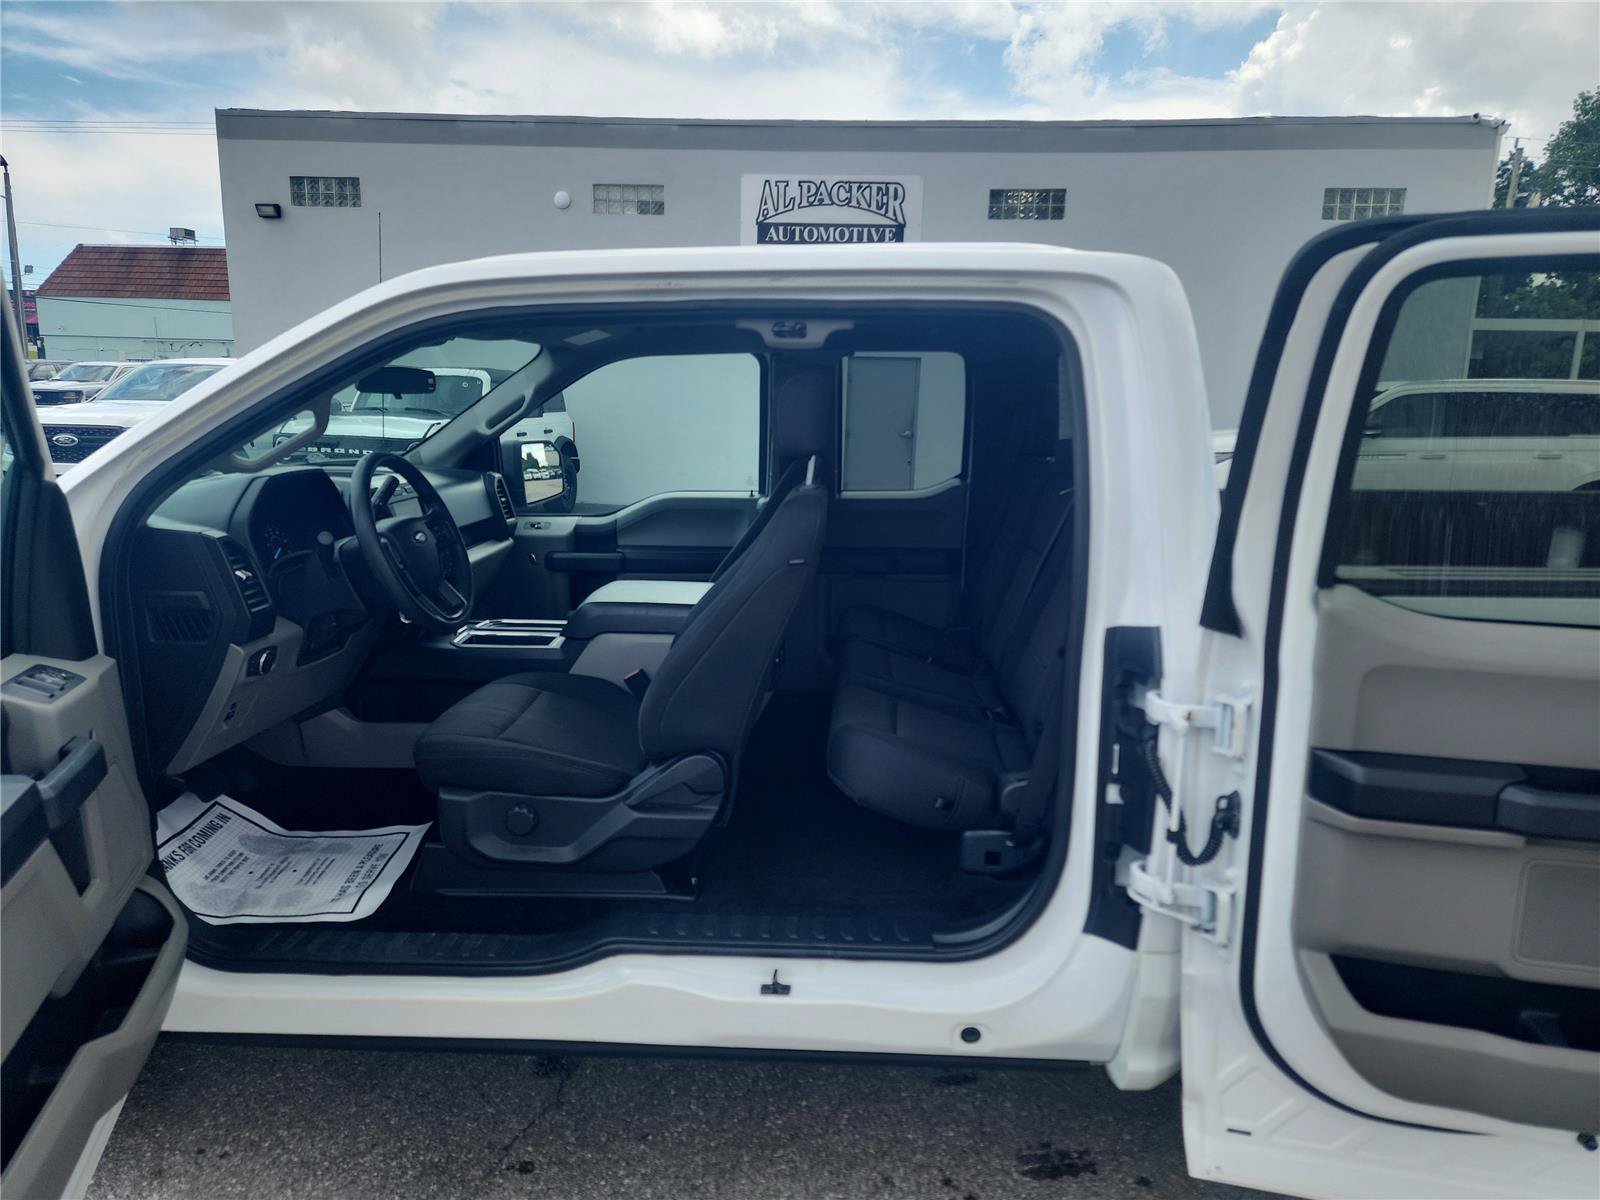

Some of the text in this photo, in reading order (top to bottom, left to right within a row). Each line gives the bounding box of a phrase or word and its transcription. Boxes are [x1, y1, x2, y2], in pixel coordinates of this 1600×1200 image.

[756, 180, 906, 226] AL PACKER
[765, 226, 896, 243] AUTOMOTIVE
[189, 819, 224, 849] COMING
[215, 812, 232, 825] IN
